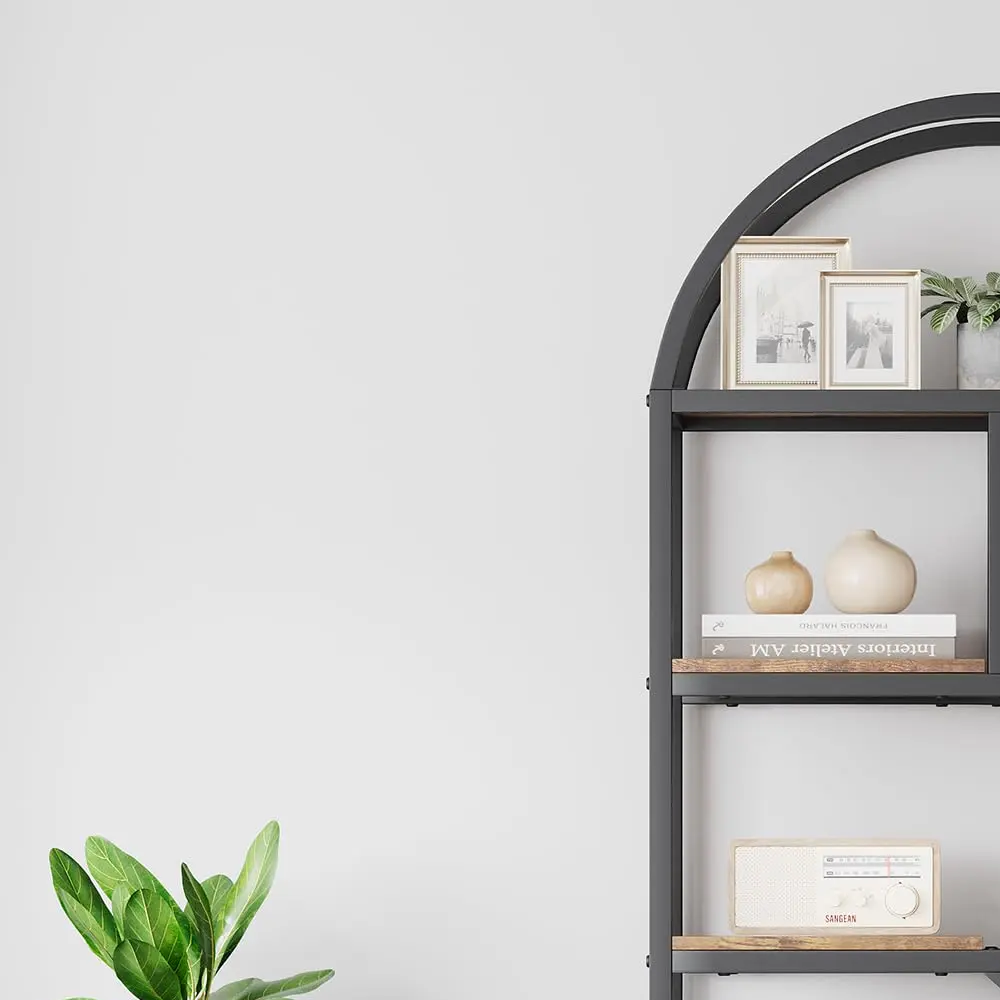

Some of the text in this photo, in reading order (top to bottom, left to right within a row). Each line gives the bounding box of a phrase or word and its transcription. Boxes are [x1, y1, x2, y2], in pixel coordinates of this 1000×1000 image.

[799, 622, 888, 630] FRANCOIS HALARD
[750, 643, 936, 657] Interiors Atelier AM
[825, 914, 857, 923] SANGEAN
